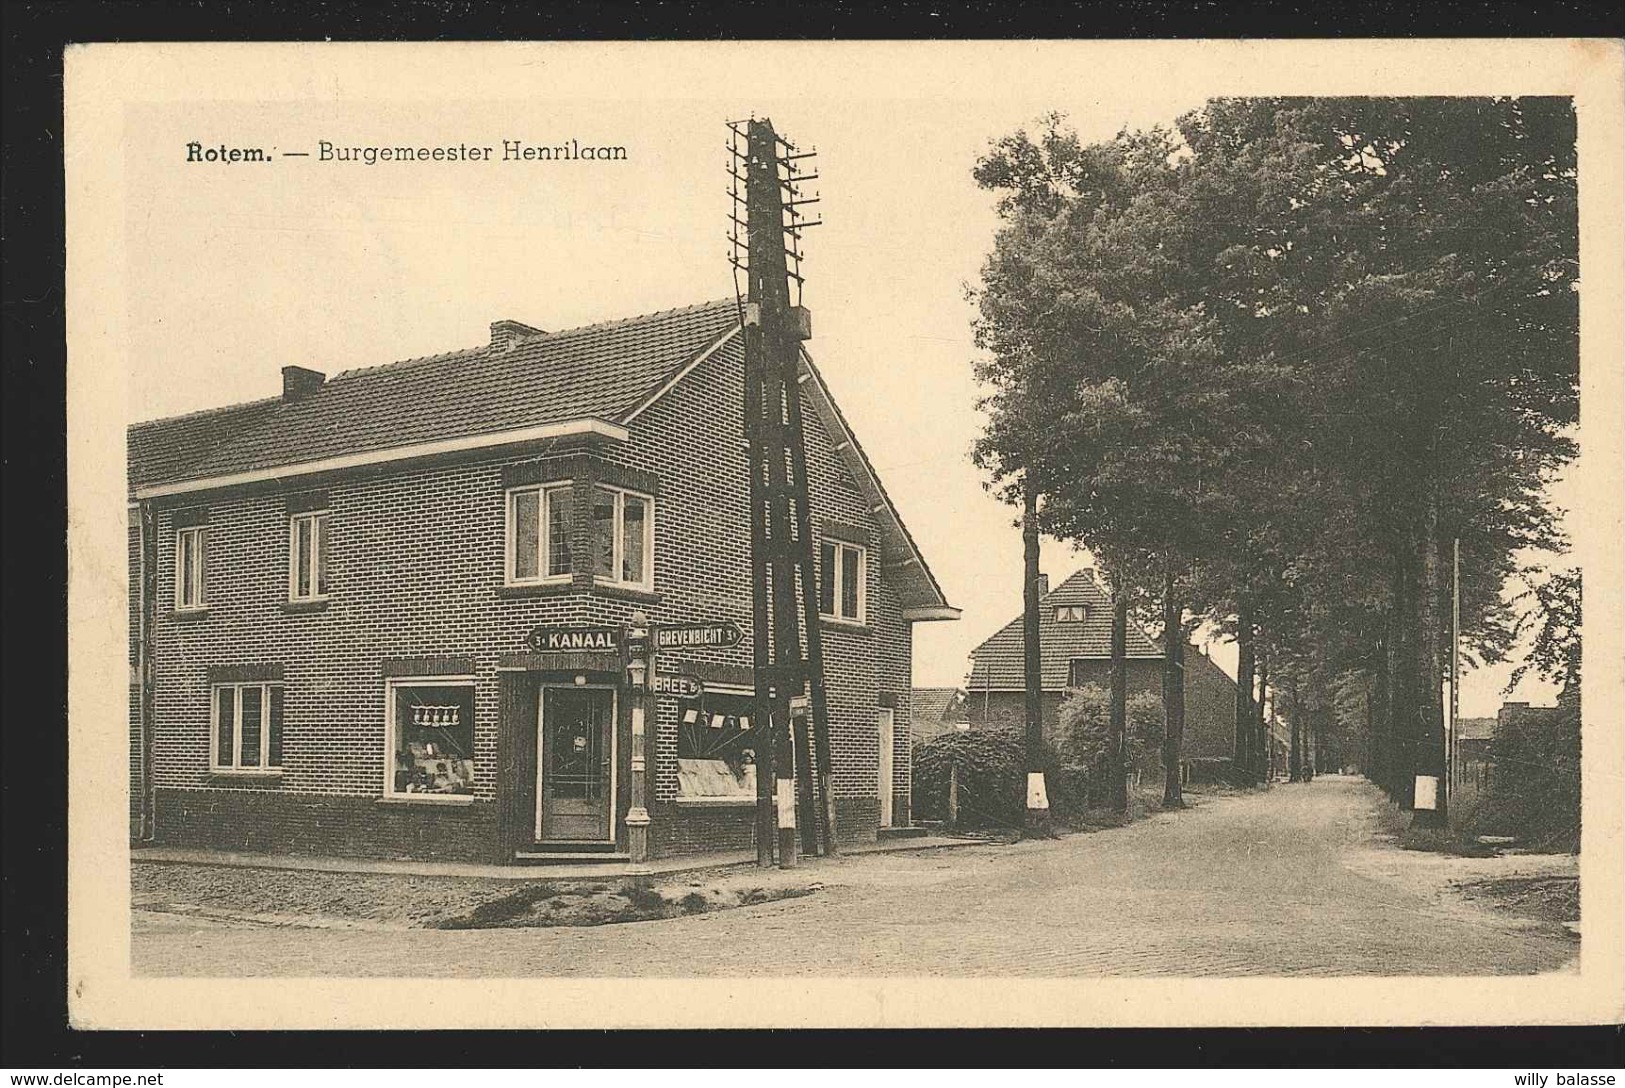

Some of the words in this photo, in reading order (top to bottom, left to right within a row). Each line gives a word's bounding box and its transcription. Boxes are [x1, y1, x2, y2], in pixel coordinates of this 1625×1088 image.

[549, 633, 617, 648] KANAAL
[659, 628, 723, 645] GREVENBICHT
[655, 677, 687, 694] BREE
